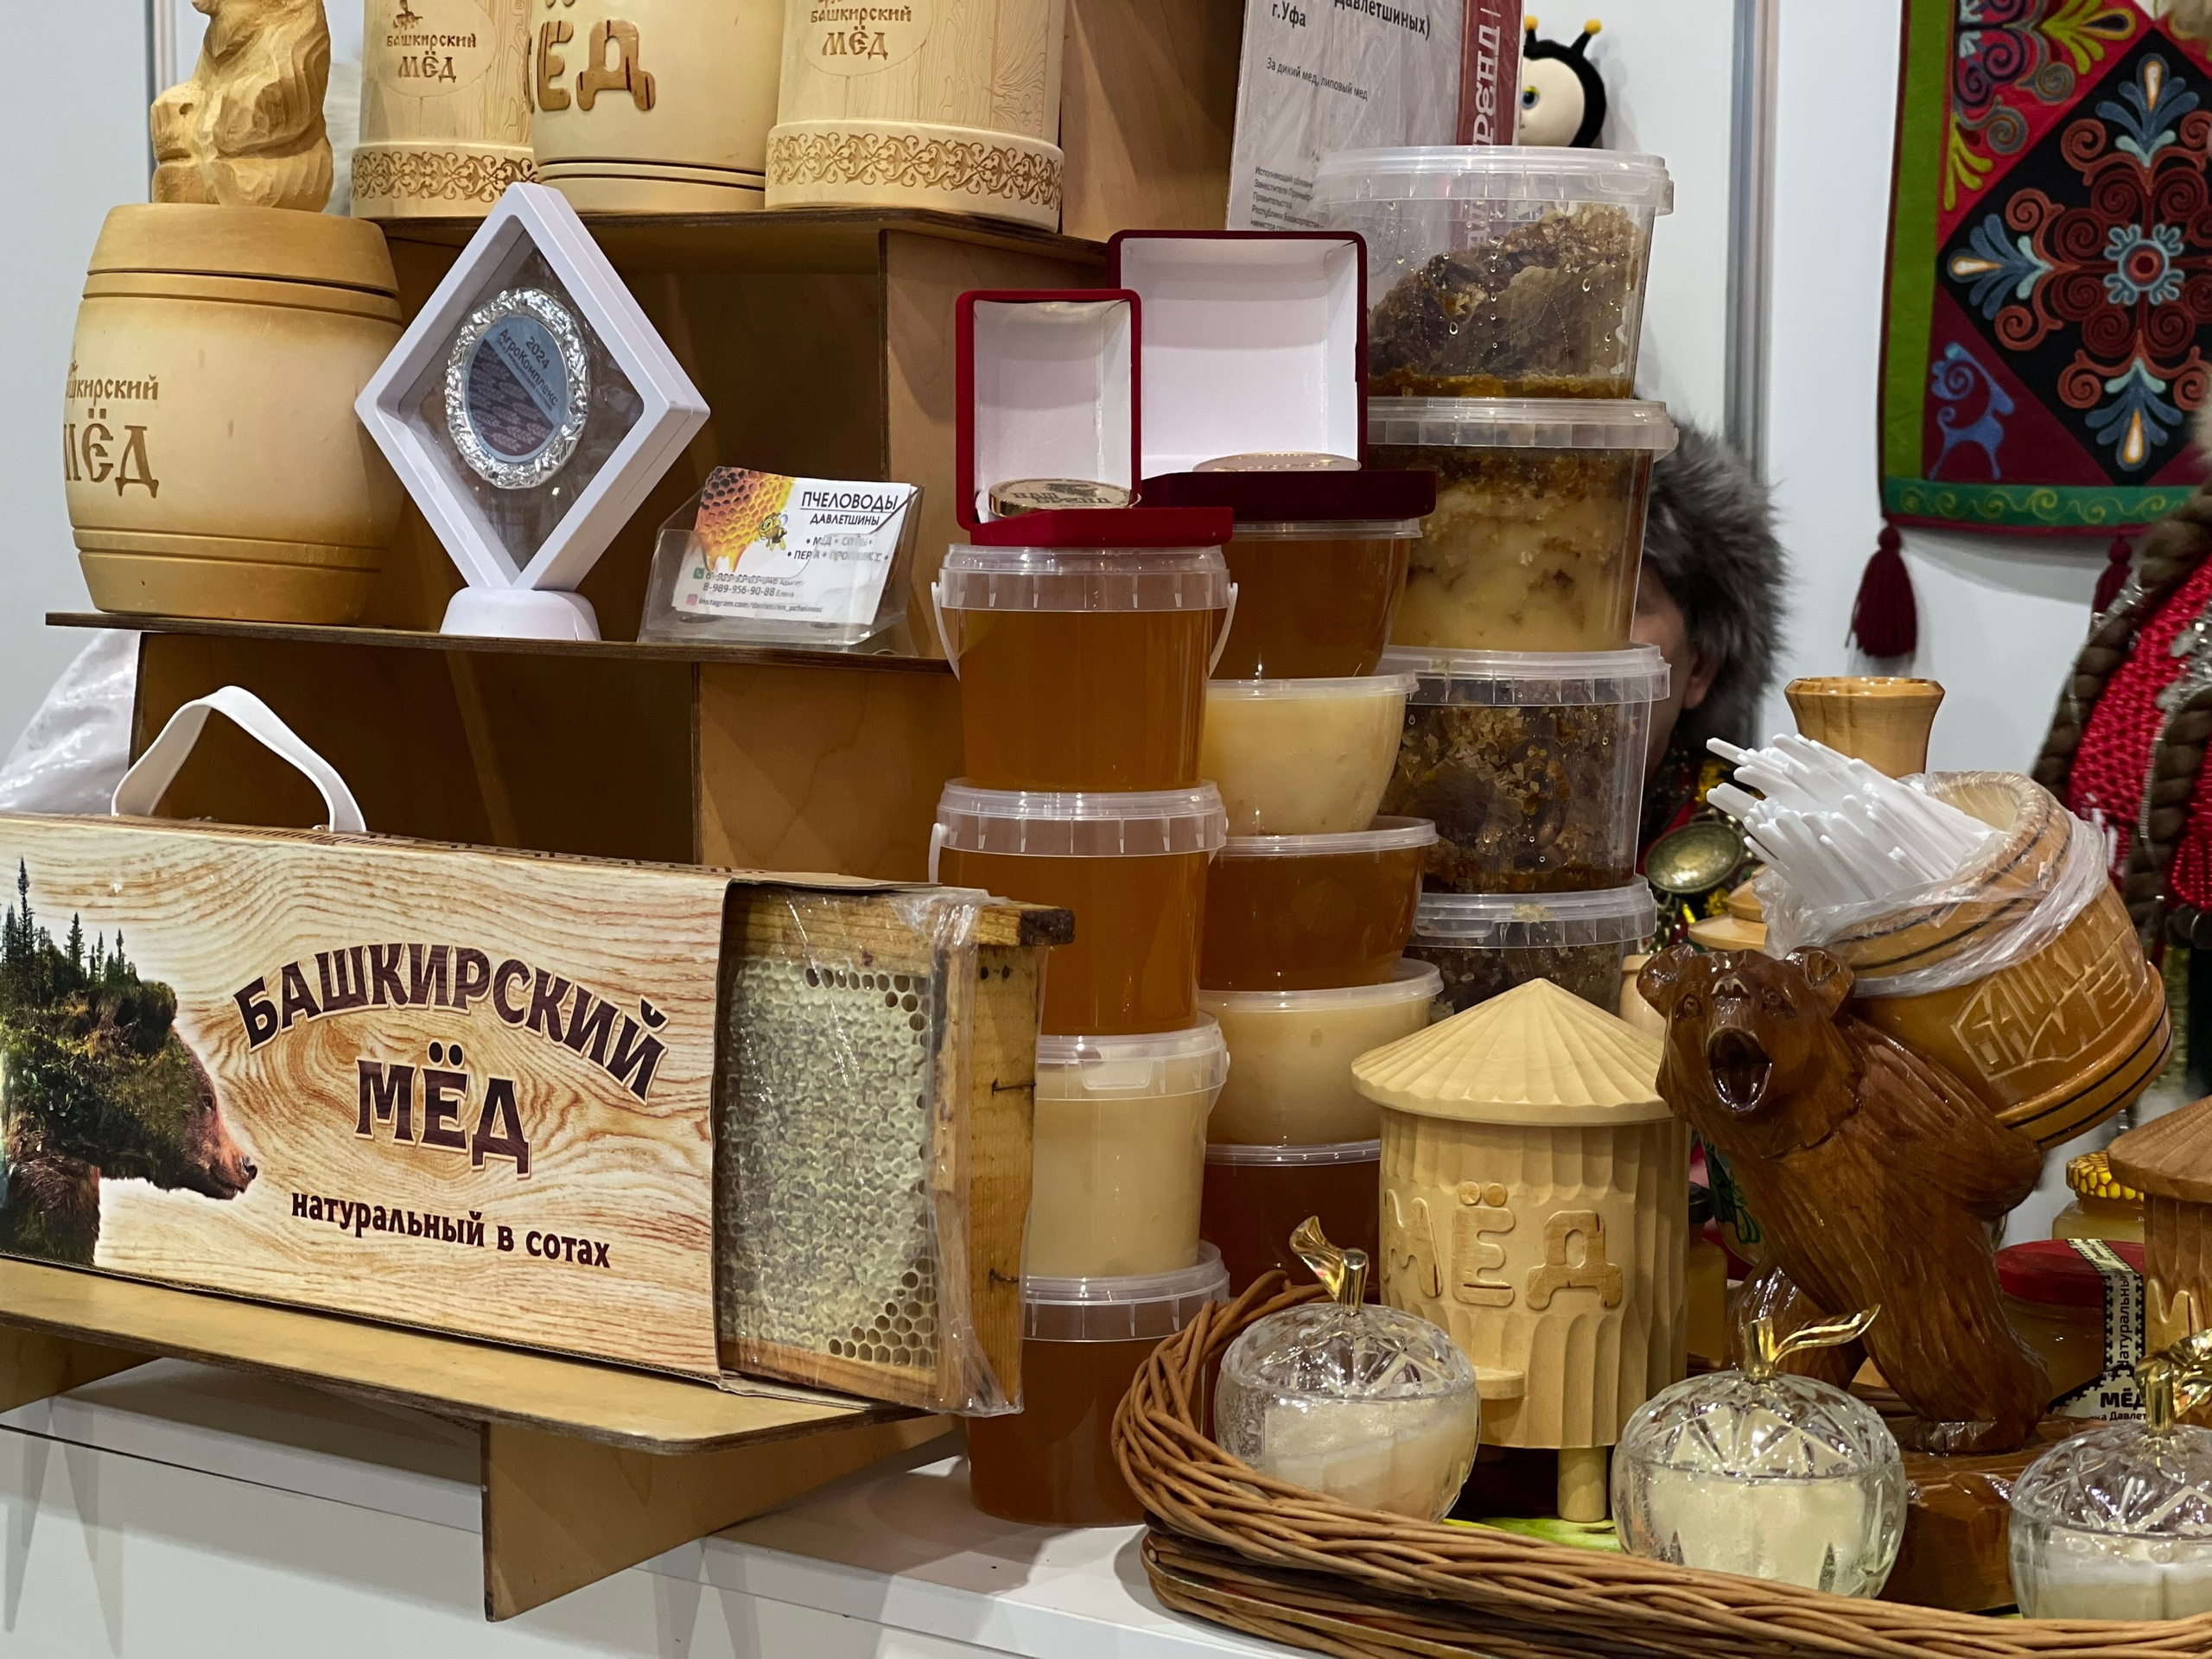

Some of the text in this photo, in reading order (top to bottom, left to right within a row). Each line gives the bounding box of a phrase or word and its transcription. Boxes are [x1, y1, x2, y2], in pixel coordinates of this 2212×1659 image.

[1272, 2, 1306, 29] г.Уфа
[524, 0, 656, 113] ЁД
[821, 25, 889, 61] МЁД
[397, 51, 457, 84] МЁД
[1267, 57, 1276, 71] За
[1277, 63, 1300, 79] дикий
[1320, 77, 1352, 95] липовый
[1353, 87, 1368, 101] мед
[499, 329, 558, 406] АгроКомплекс
[525, 335, 550, 370] 2024
[801, 491, 899, 512] ПЧЕЛОВОДЫ
[810, 513, 880, 526] ДАВЛЕТШИНЫ
[702, 582, 776, 597] 8-989-956-90-88
[234, 943, 668, 1105] БАШКИРСКИЙ
[355, 1041, 530, 1176] МЁД
[291, 1192, 611, 1268] натуральный в сотах
[1382, 1180, 1623, 1311] МЁД
